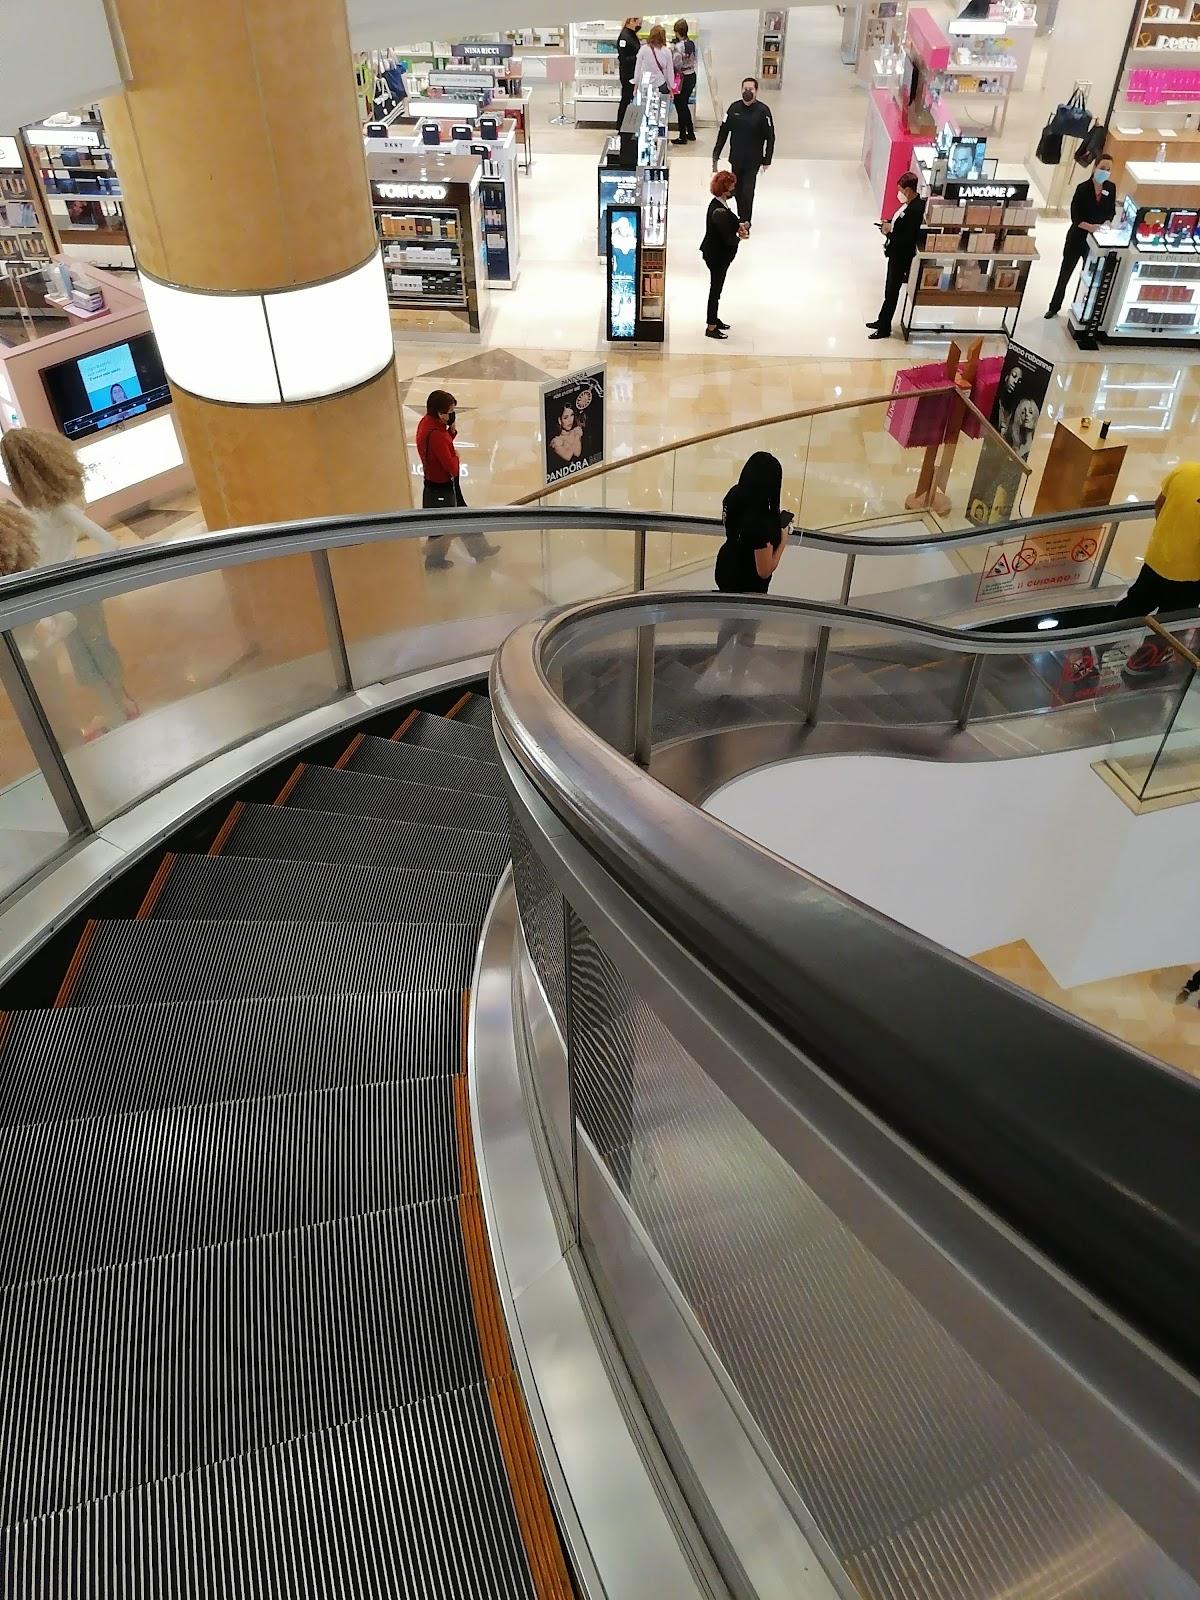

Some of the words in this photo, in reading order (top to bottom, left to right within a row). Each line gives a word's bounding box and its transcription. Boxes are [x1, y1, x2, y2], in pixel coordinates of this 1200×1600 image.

[481, 47, 500, 55] RICCI
[376, 183, 408, 199] TOM
[408, 184, 447, 200] FORD
[958, 185, 1006, 198] LANCÔME
[1088, 310, 1101, 337] RALPH
[1008, 342, 1025, 356] paco
[1024, 351, 1053, 372] rabanne
[561, 372, 588, 386] PANDORA
[545, 458, 589, 483] PANDORA
[1027, 575, 1071, 587] CUIDADO
